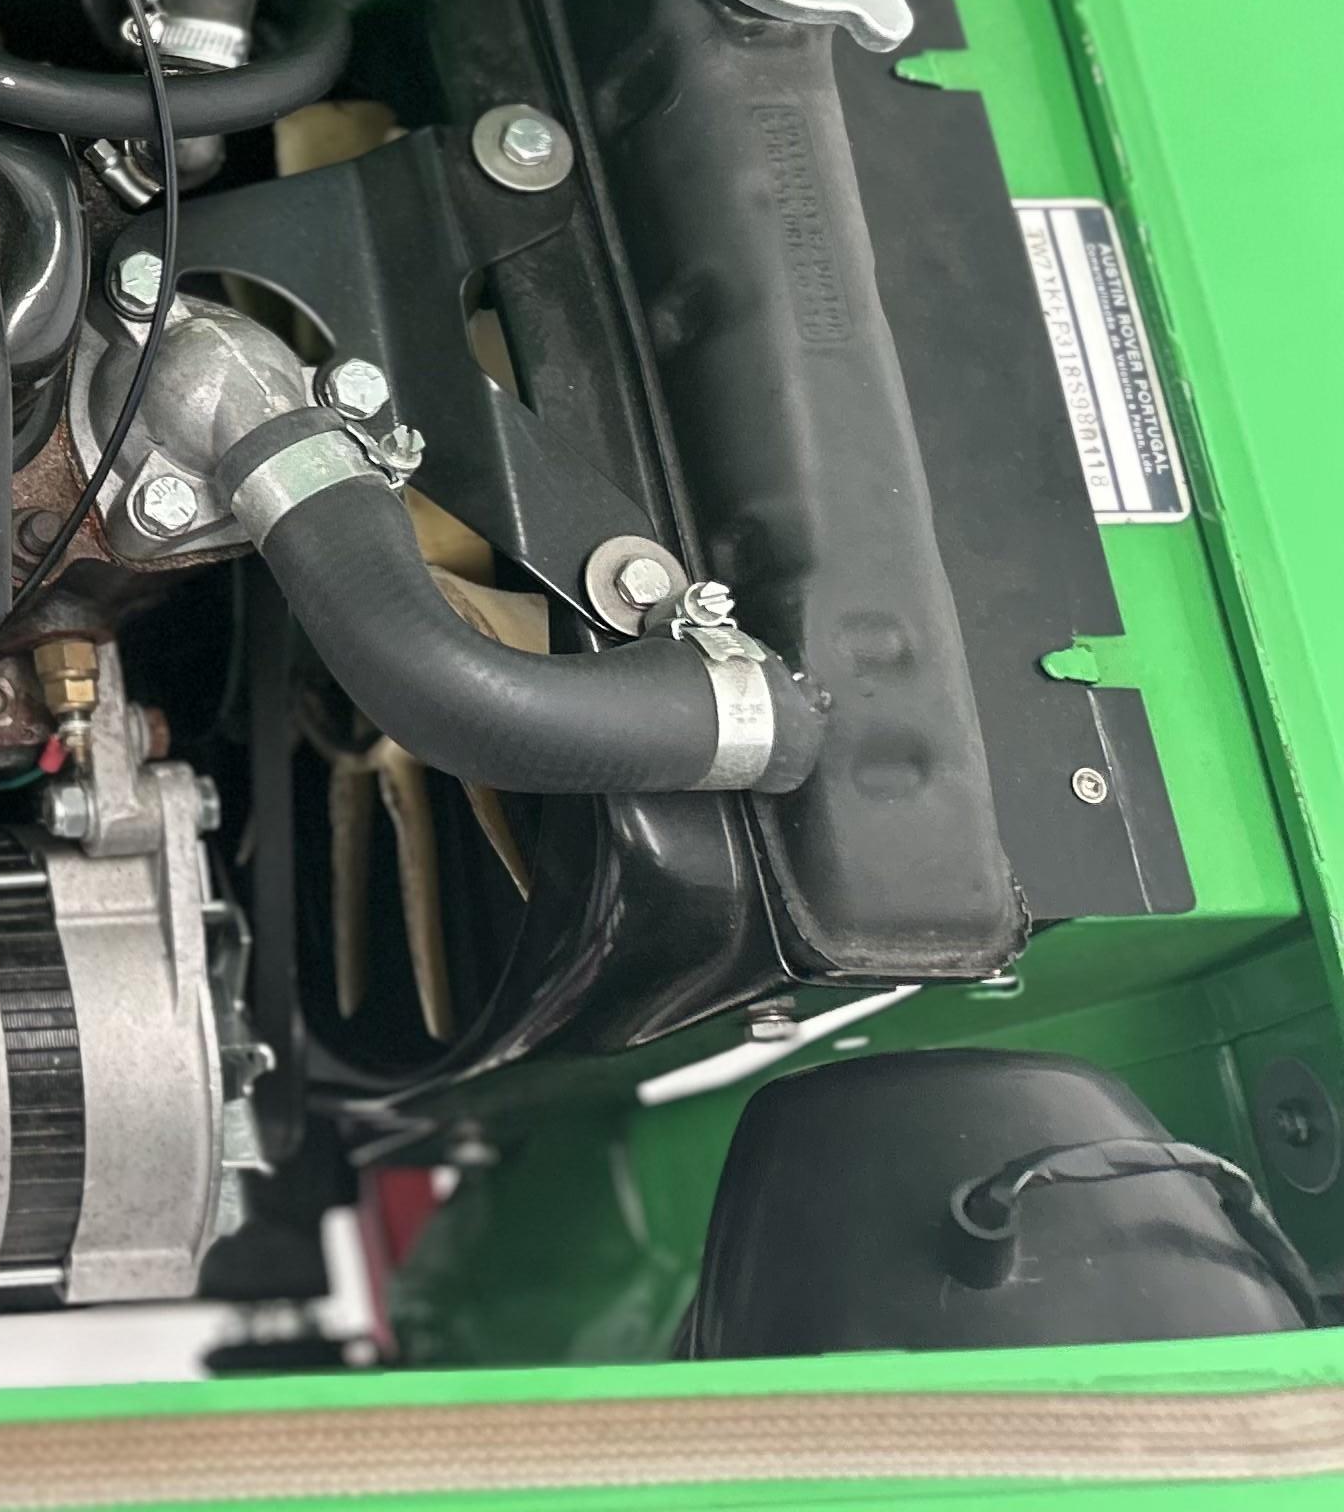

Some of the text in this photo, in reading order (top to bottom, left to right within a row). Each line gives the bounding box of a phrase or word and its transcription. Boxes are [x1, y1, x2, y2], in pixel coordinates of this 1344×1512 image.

[1099, 243, 1169, 474] AUSTIN ROVER PORTUGAL
